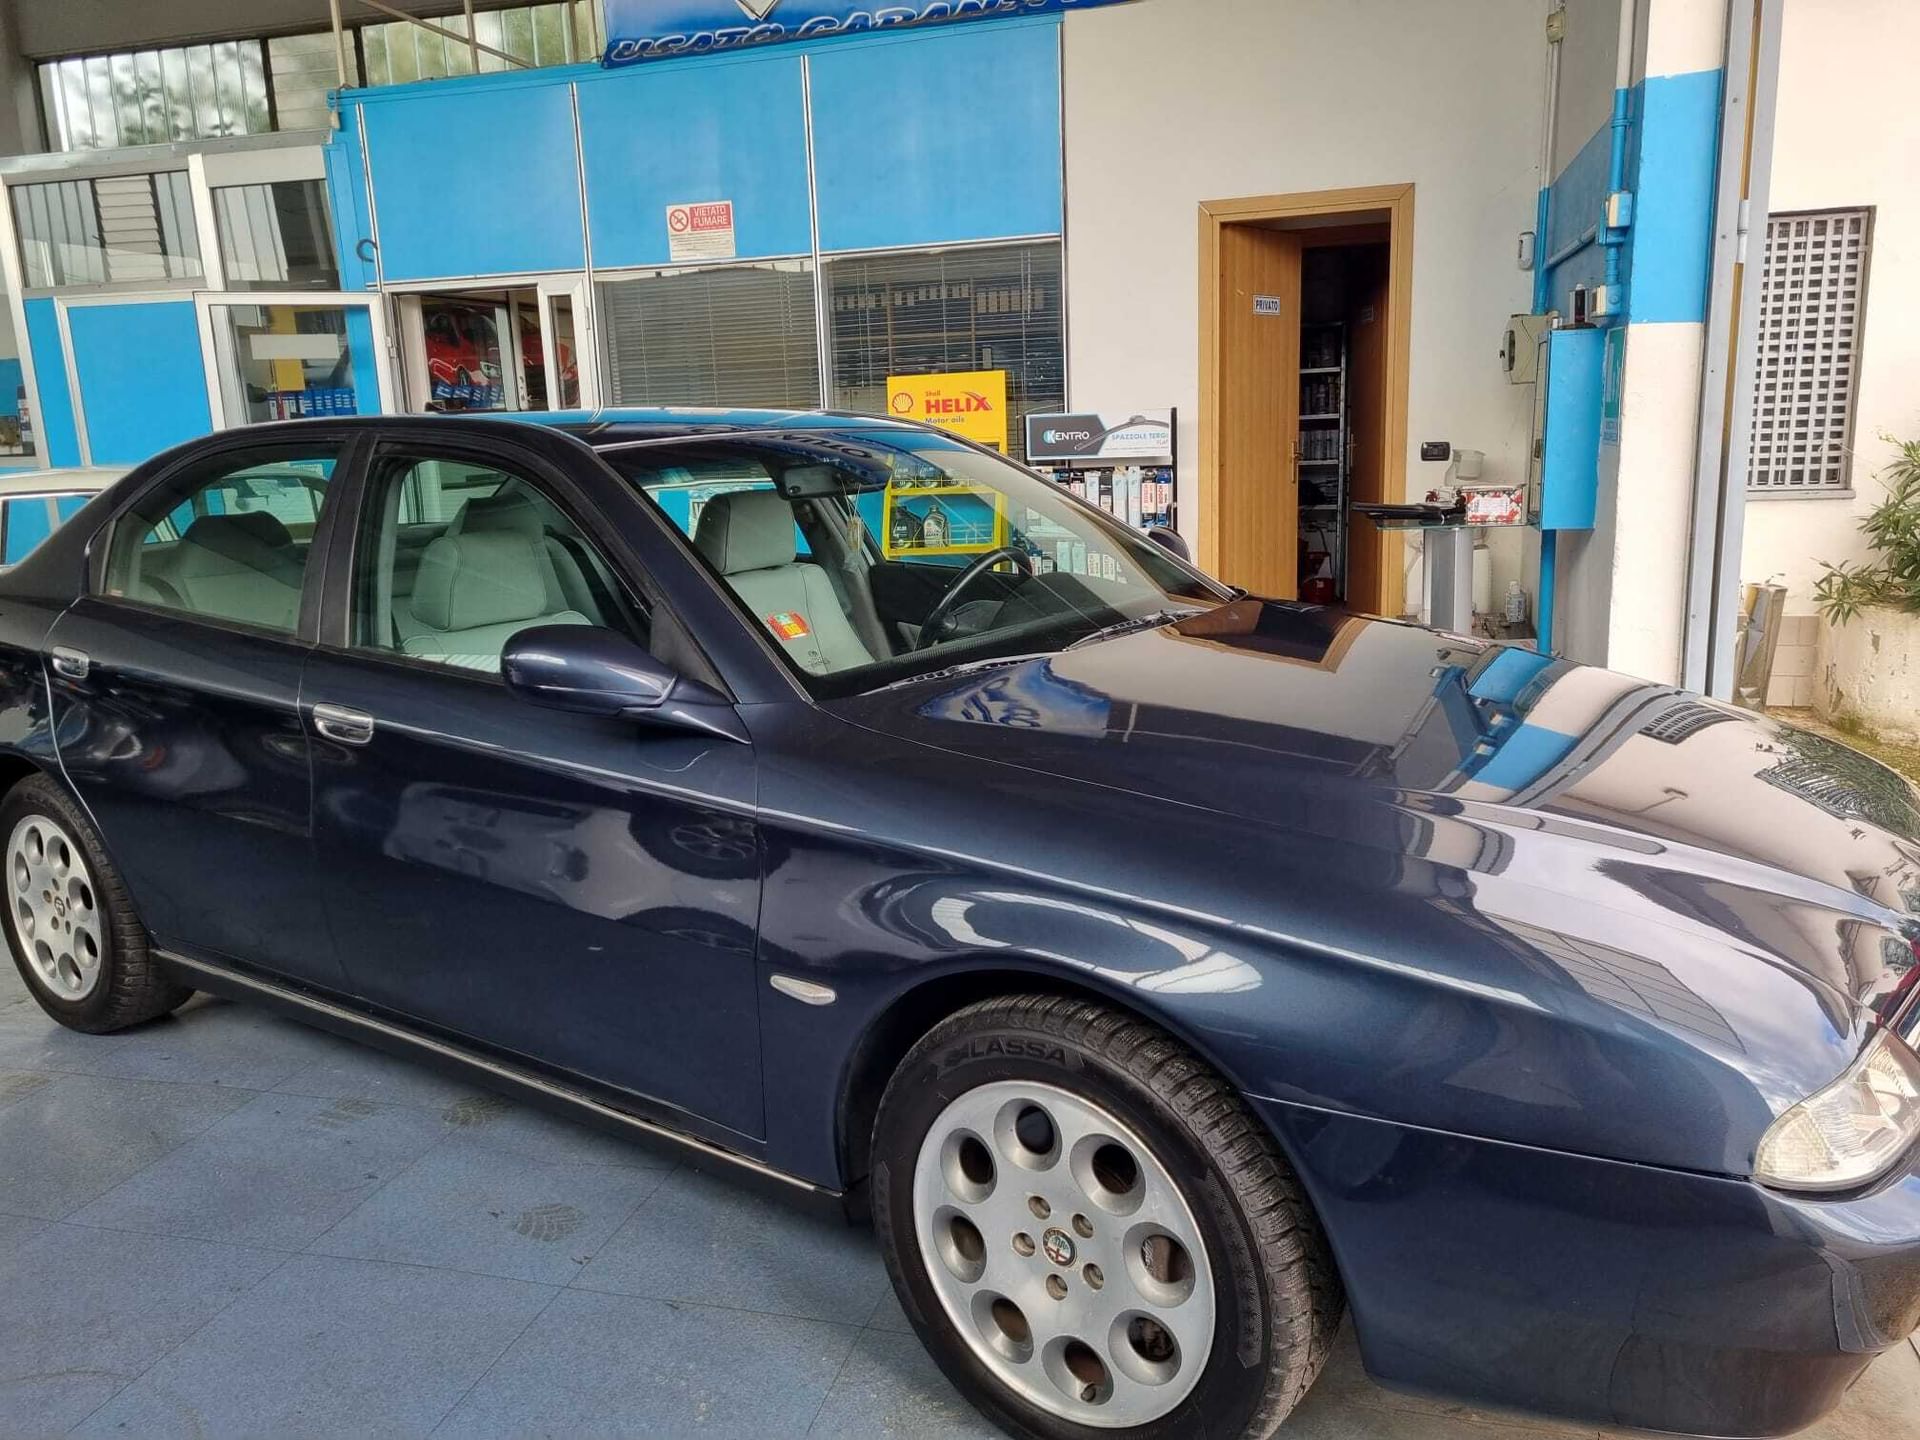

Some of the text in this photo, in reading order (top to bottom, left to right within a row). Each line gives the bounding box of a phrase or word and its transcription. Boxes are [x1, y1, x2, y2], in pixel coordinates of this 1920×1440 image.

[693, 206, 726, 216] VIETATO
[693, 215, 728, 225] FUMARE
[1255, 299, 1278, 311] PRIVATO
[925, 393, 992, 414] HELIX
[925, 417, 949, 425] Motor
[1043, 430, 1090, 443] KENTRO
[969, 1036, 1067, 1067] LASSA
